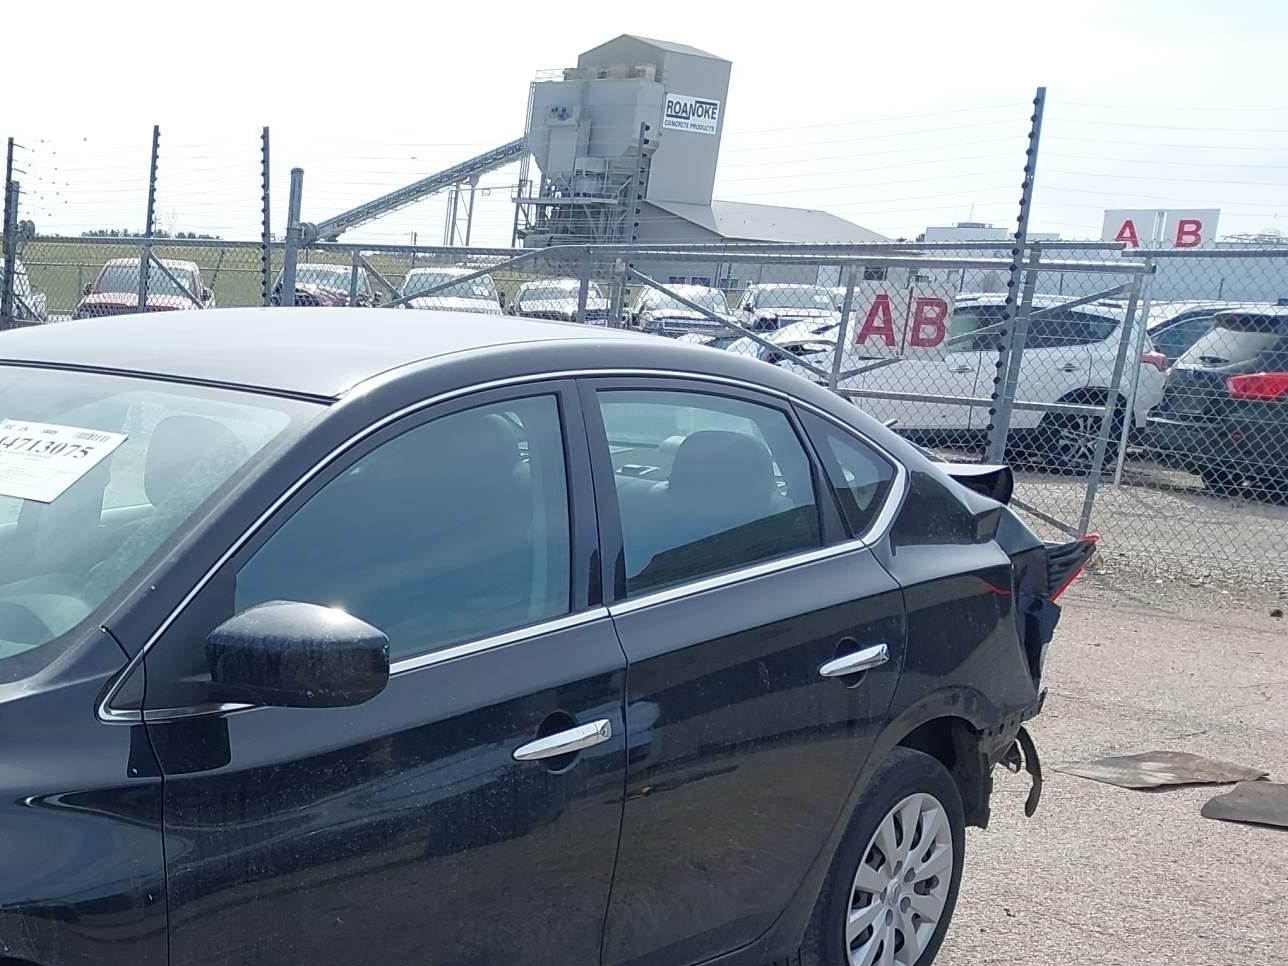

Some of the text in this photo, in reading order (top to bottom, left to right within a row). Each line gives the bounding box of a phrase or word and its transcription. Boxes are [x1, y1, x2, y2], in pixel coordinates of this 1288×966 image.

[666, 100, 718, 120] ROANOKE
[664, 119, 715, 133] CONCRETE PRODUCTS
[1114, 219, 1203, 248] A B
[855, 294, 948, 348] A B
